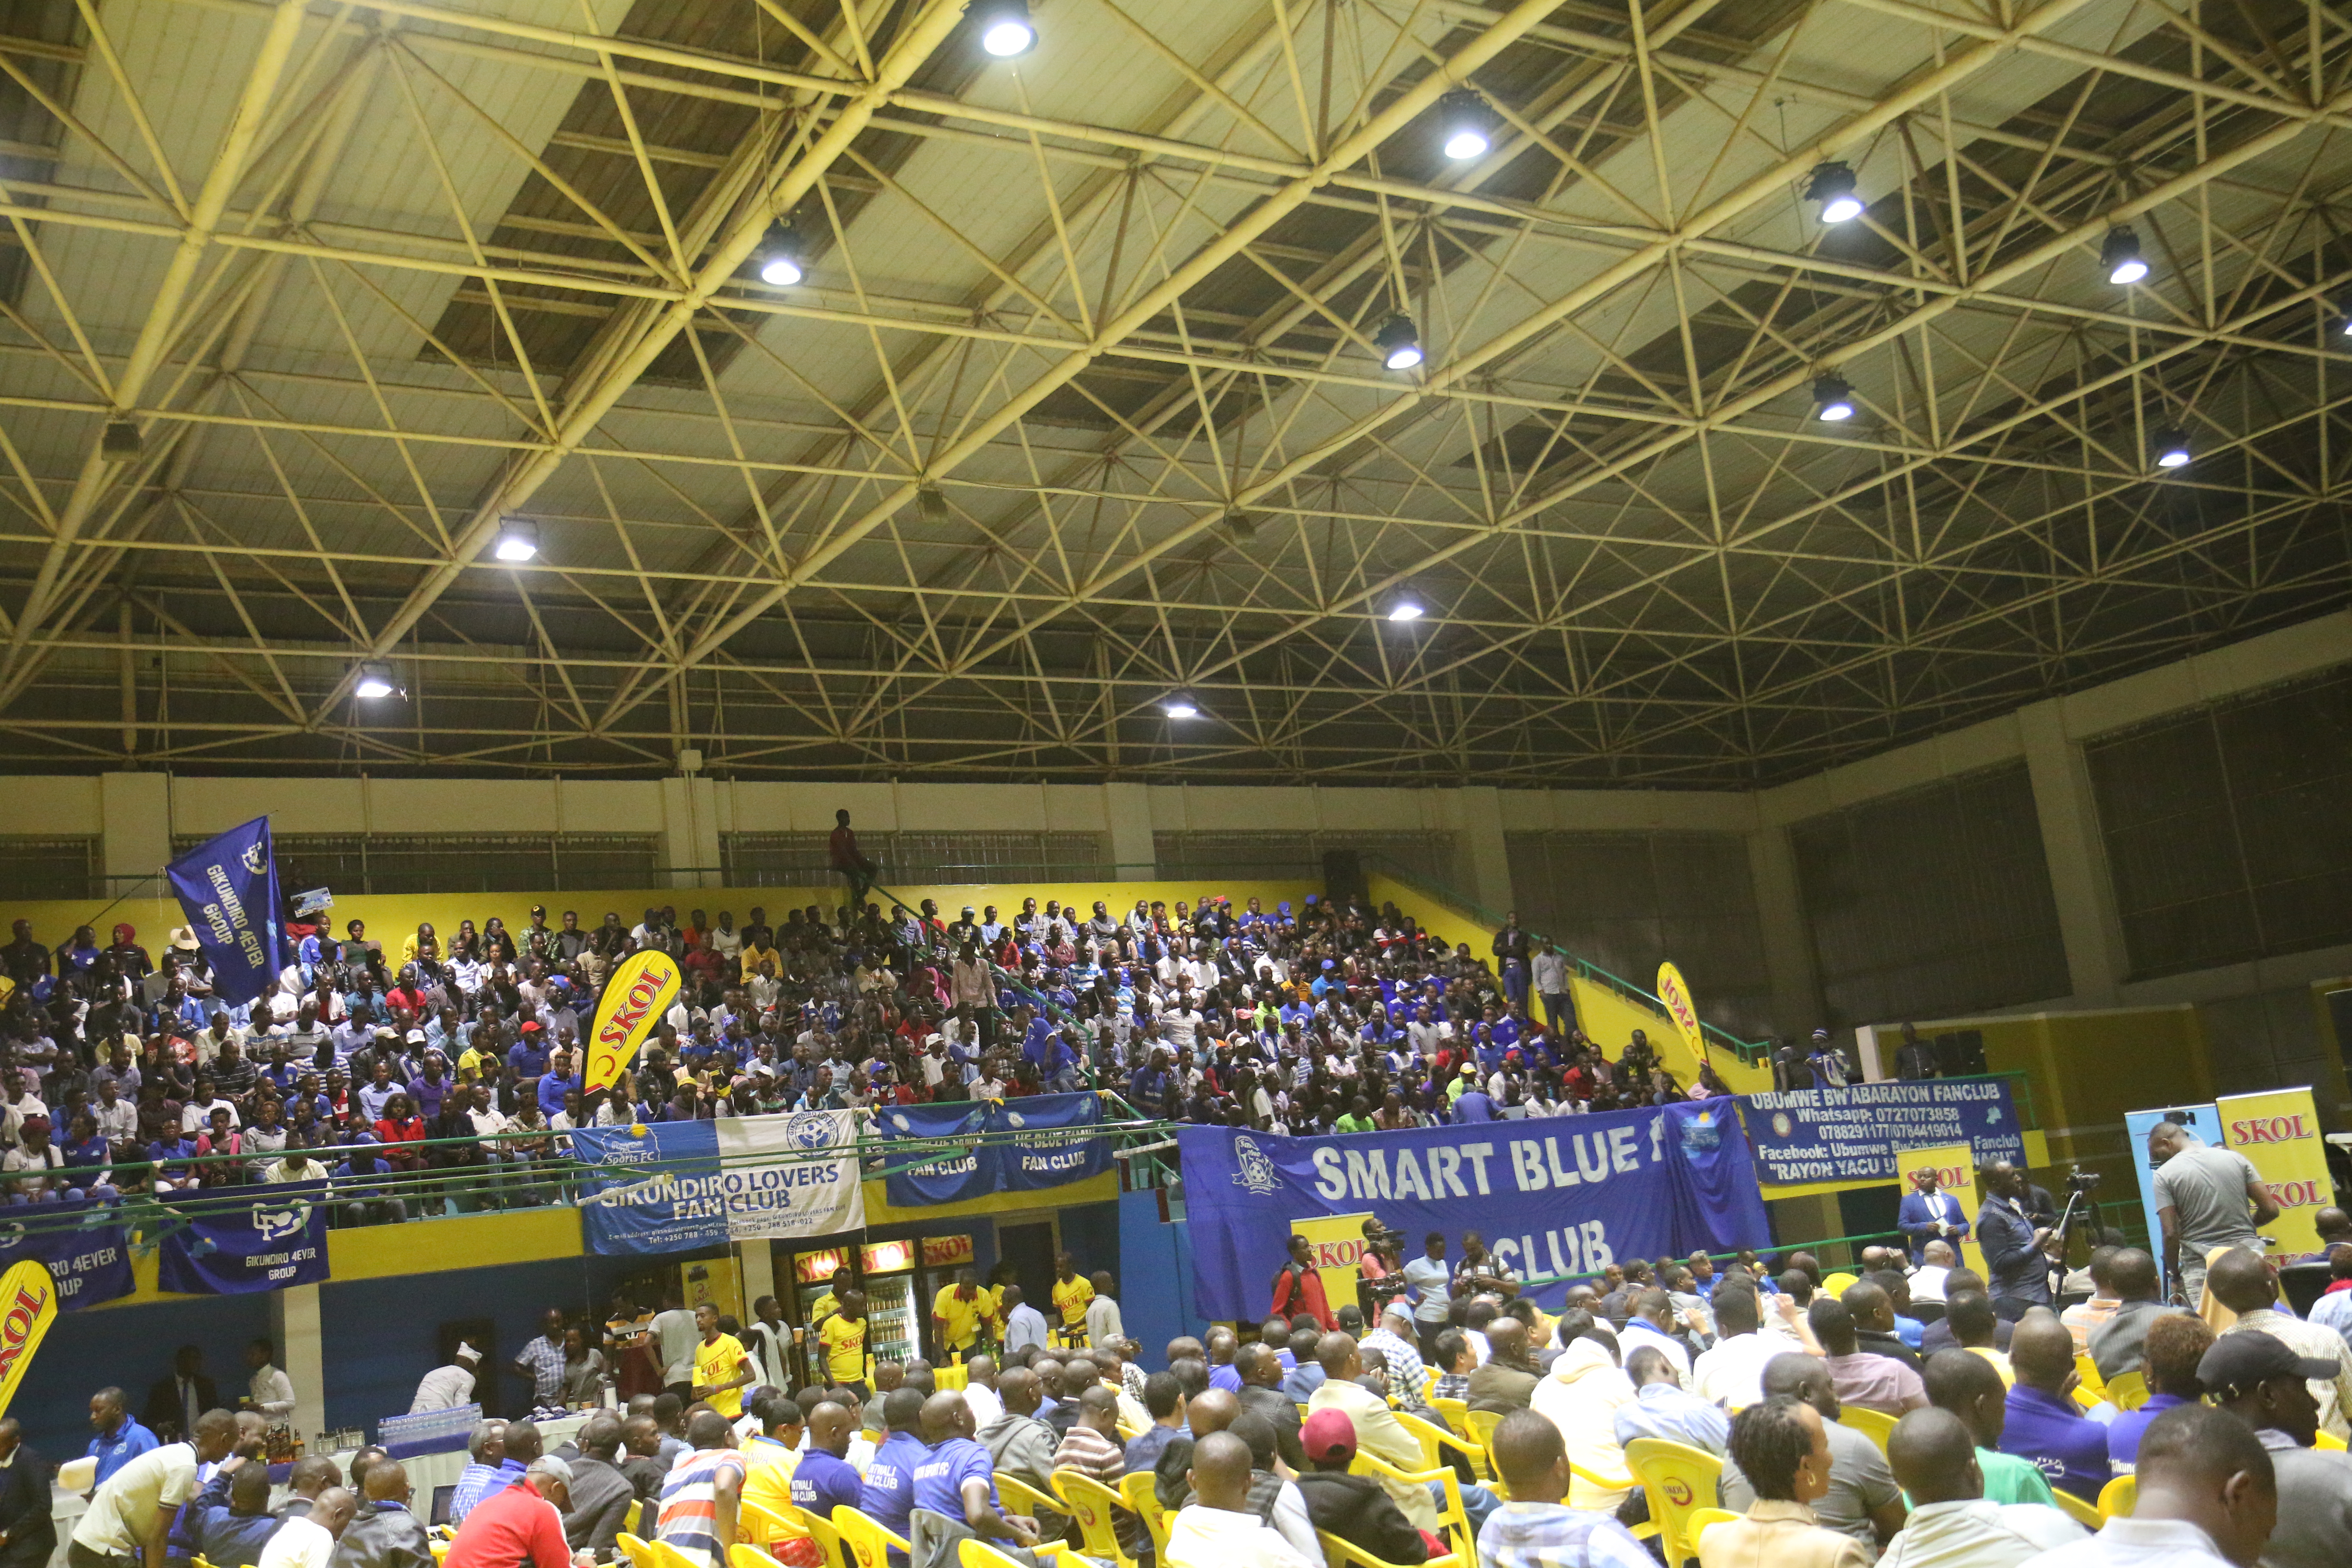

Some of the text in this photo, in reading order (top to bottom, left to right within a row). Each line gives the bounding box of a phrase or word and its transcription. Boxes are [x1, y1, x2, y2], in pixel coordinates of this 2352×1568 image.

[203, 903, 234, 944] GROUP
[207, 864, 265, 969] GIKUNDIRO 4EVER
[599, 968, 671, 1051] SKOL
[1750, 1090, 1821, 1109] UBUMWE
[1933, 1084, 2000, 1102] FANCLUB
[789, 1112, 836, 1136] GIKUNDIRO LOVERS
[1795, 1108, 1873, 1123] Whatsapp:
[1035, 1132, 1063, 1149] BLUE
[2232, 1114, 2313, 1145] SKOL
[612, 1140, 643, 1149] Rayon
[1758, 1144, 1828, 1160] Facebook:
[1830, 1142, 1887, 1157] Ubumwe
[1973, 1134, 2020, 1149] Fanclub
[607, 1152, 655, 1165] Sports FC
[938, 1156, 978, 1176] CLUB
[1022, 1151, 1086, 1170] FAN CLUB
[1312, 1142, 1493, 1200] SMART
[1510, 1126, 1639, 1191] BLUE
[1836, 1158, 1880, 1175] YACU
[601, 1164, 839, 1207] GIKUNDIRO LOVERS
[1907, 1167, 1970, 1192] SOL
[673, 1189, 791, 1220] FAN CLUB
[2249, 1180, 2326, 1209] KOL
[72, 1247, 117, 1272] 4EVER
[246, 1247, 316, 1267] GIKUNDIRO 4EVER
[861, 1240, 914, 1274] SKOL
[924, 1238, 972, 1264] SKOL
[1492, 1219, 1613, 1284] CLUB
[269, 1266, 297, 1280] GROUP
[796, 1248, 850, 1283] SKOL
[0, 1283, 47, 1382] KOL
[740, 1451, 769, 1464] ANDA
[939, 1462, 949, 1475] FC
[791, 1479, 812, 1490] NTWALI
[874, 1475, 898, 1489] CLUB
[799, 1491, 817, 1501] CLUB
